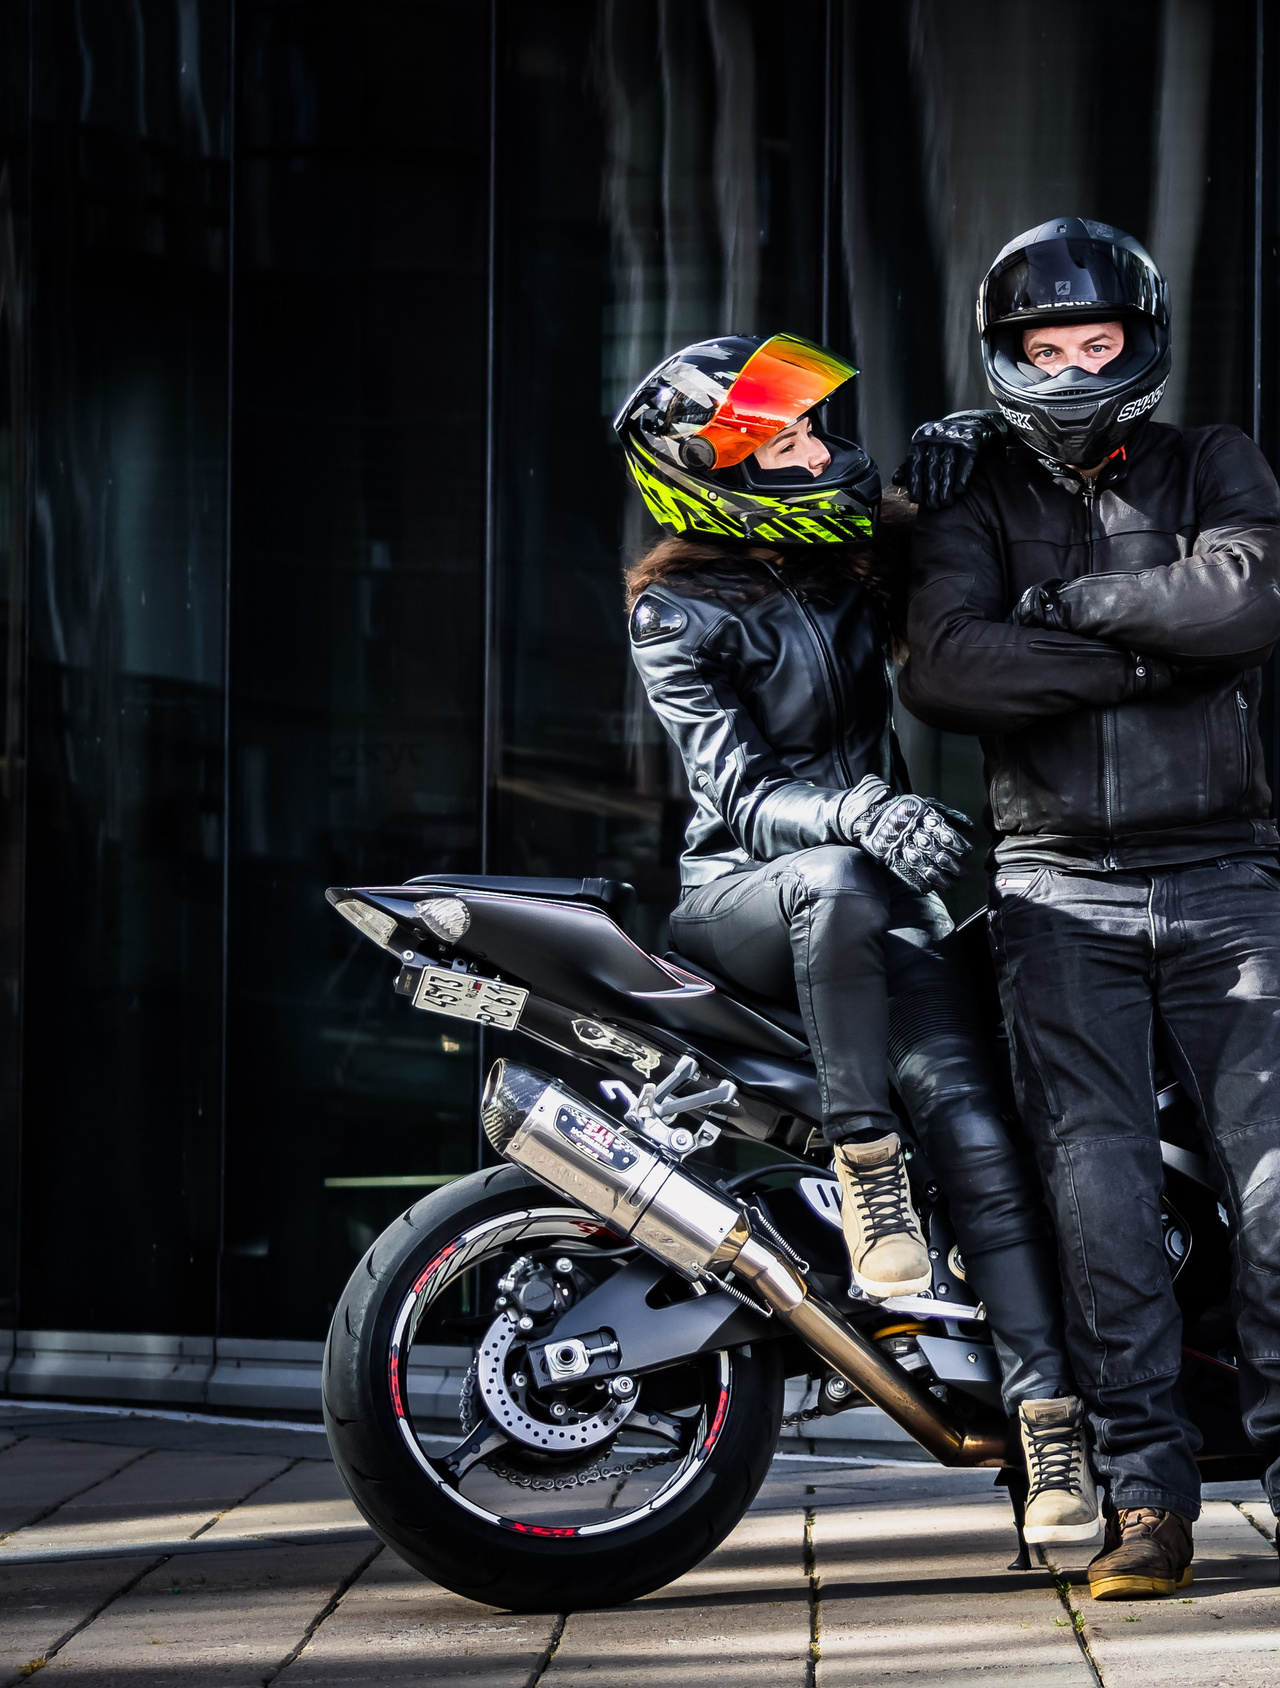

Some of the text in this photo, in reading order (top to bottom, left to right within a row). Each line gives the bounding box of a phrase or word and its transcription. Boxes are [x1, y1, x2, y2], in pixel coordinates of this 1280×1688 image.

[1117, 375, 1169, 422] SHAR
[423, 975, 464, 1008] 4513
[508, 1521, 576, 1537] GSX
